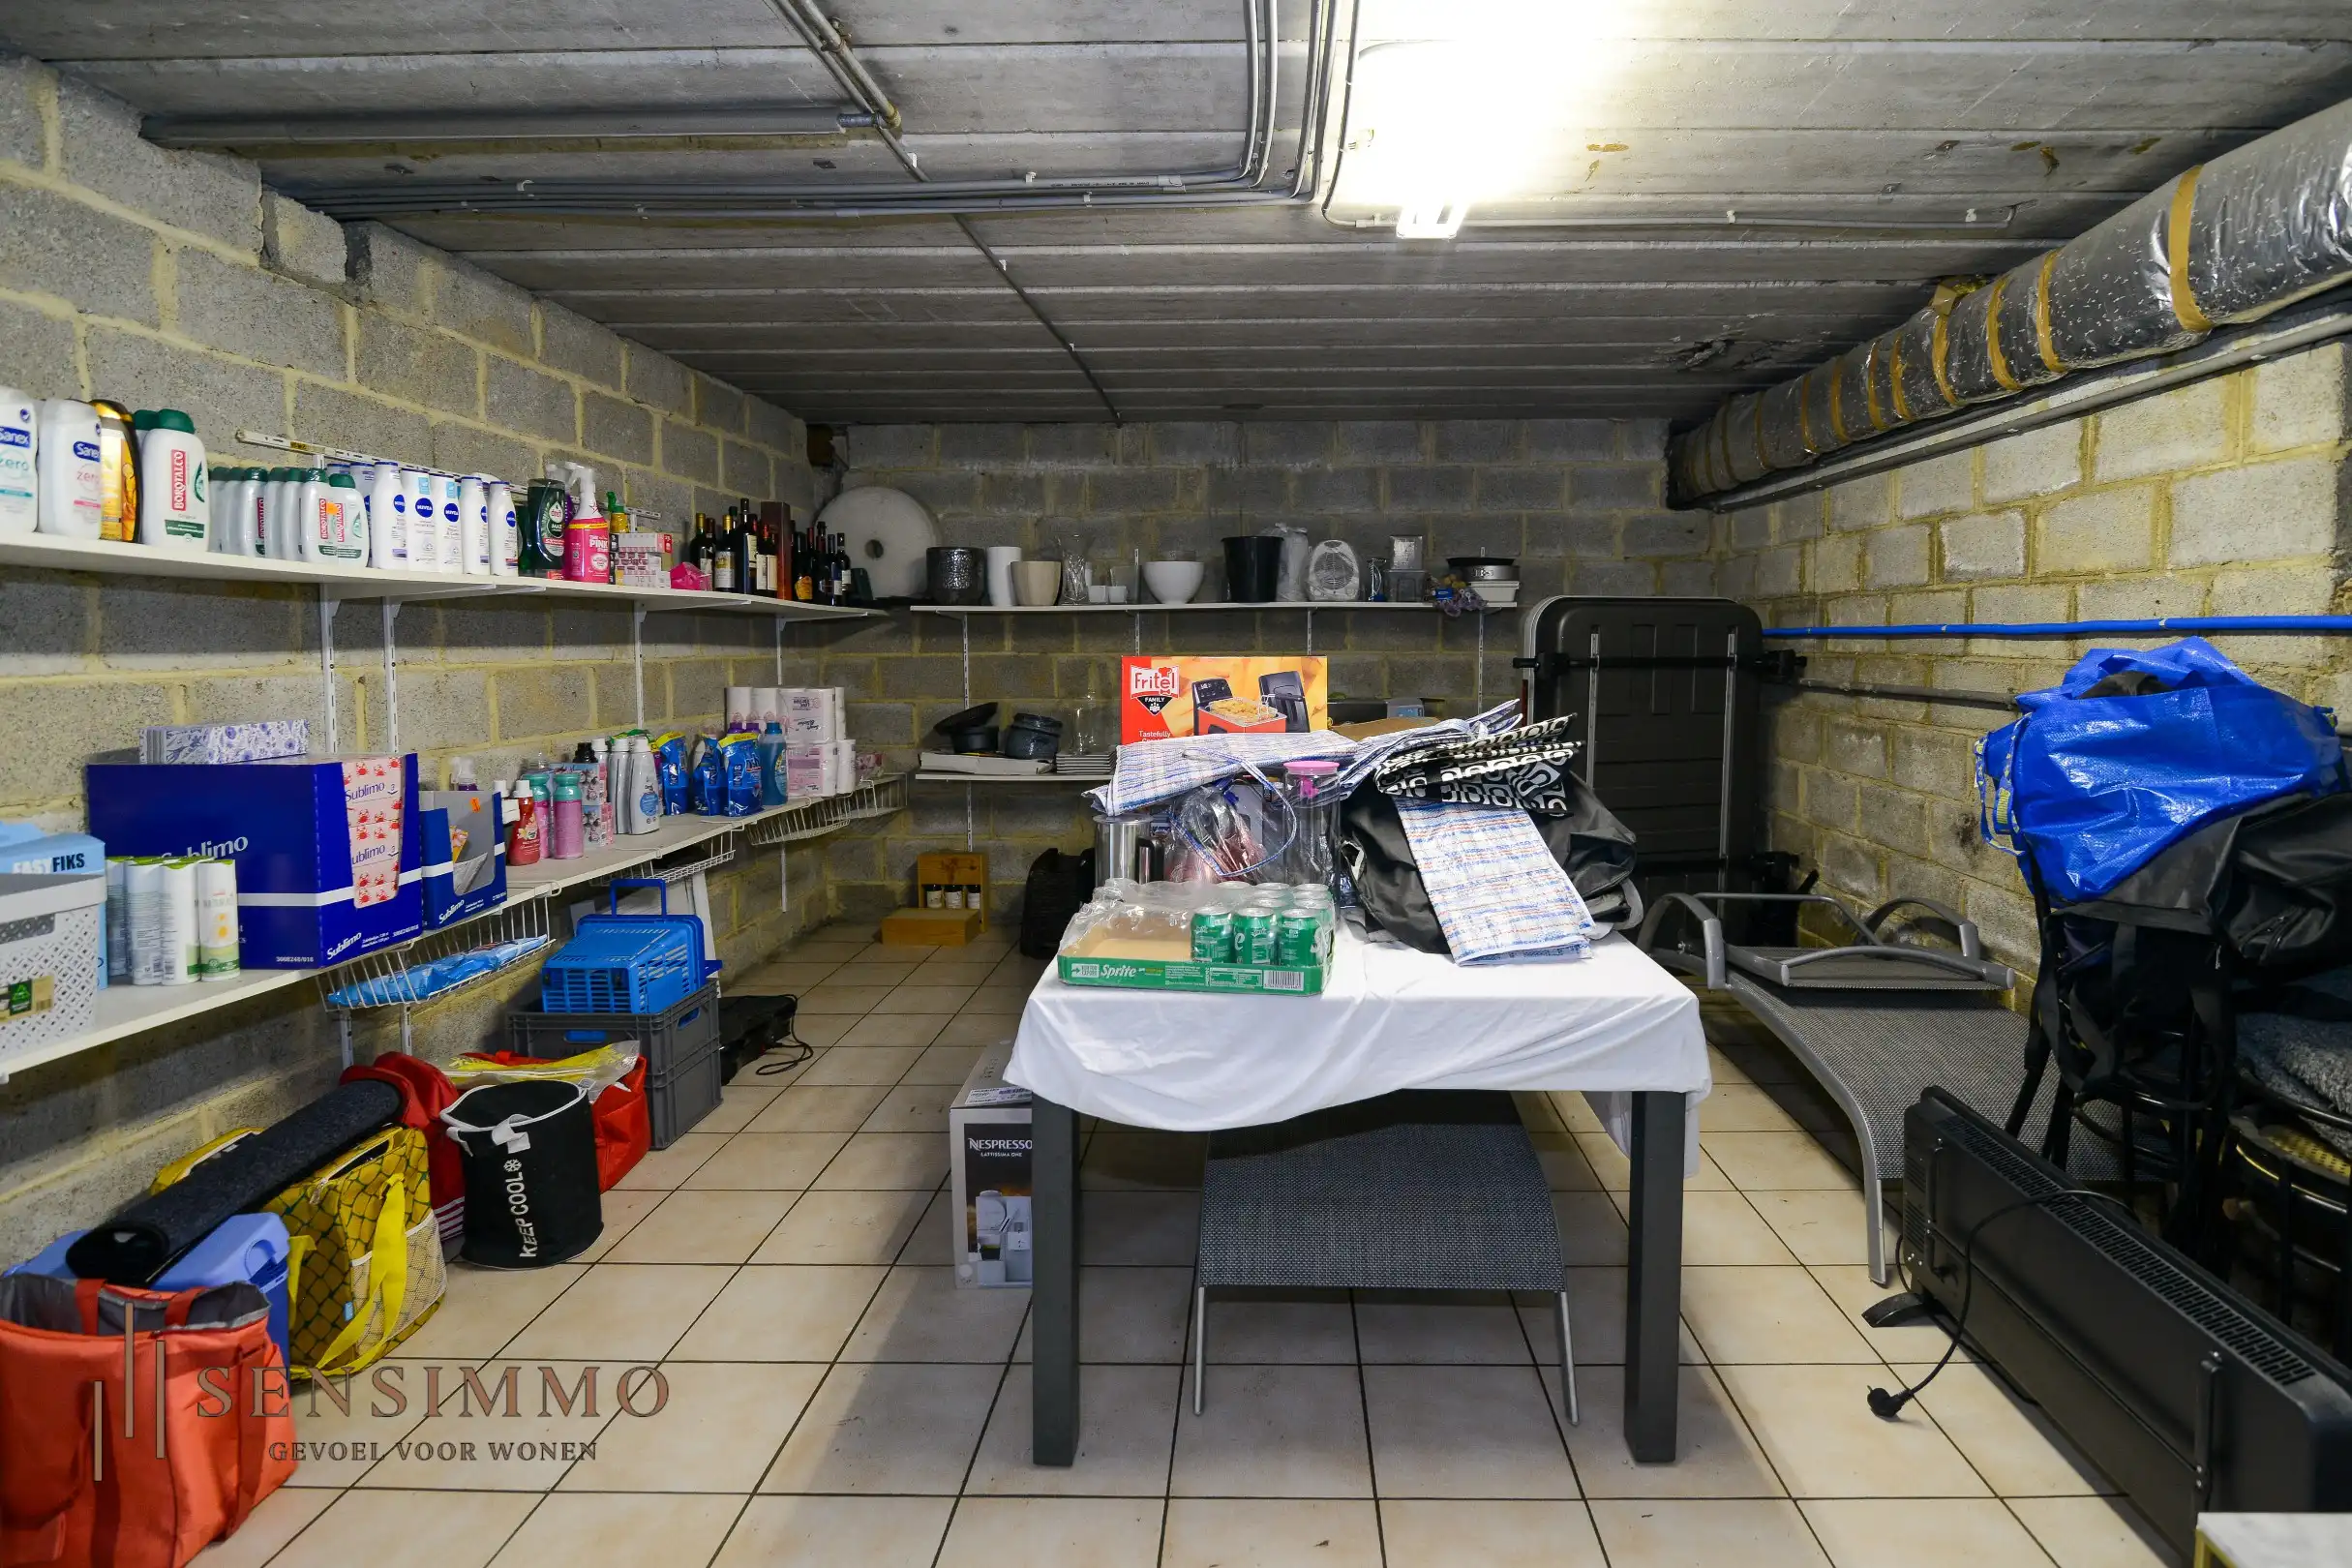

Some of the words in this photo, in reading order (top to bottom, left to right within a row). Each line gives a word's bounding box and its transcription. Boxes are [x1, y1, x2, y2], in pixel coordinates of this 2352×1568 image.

[76, 442, 101, 460] Sane
[172, 450, 186, 511] BOROTALCO
[319, 498, 329, 539] BOROTALCO
[1134, 672, 1175, 689] Fritel
[1138, 730, 1171, 739] Tastefully
[345, 782, 386, 803] Sublimo
[161, 835, 249, 859] blimo
[351, 844, 386, 865] ublimo
[438, 899, 465, 924] Sublimo
[326, 932, 362, 960] Sublimo
[1100, 964, 1137, 980] Sprite
[968, 1137, 1033, 1151] NESPRESSO
[504, 1171, 529, 1216] COOL
[515, 1218, 538, 1257] KEEP
